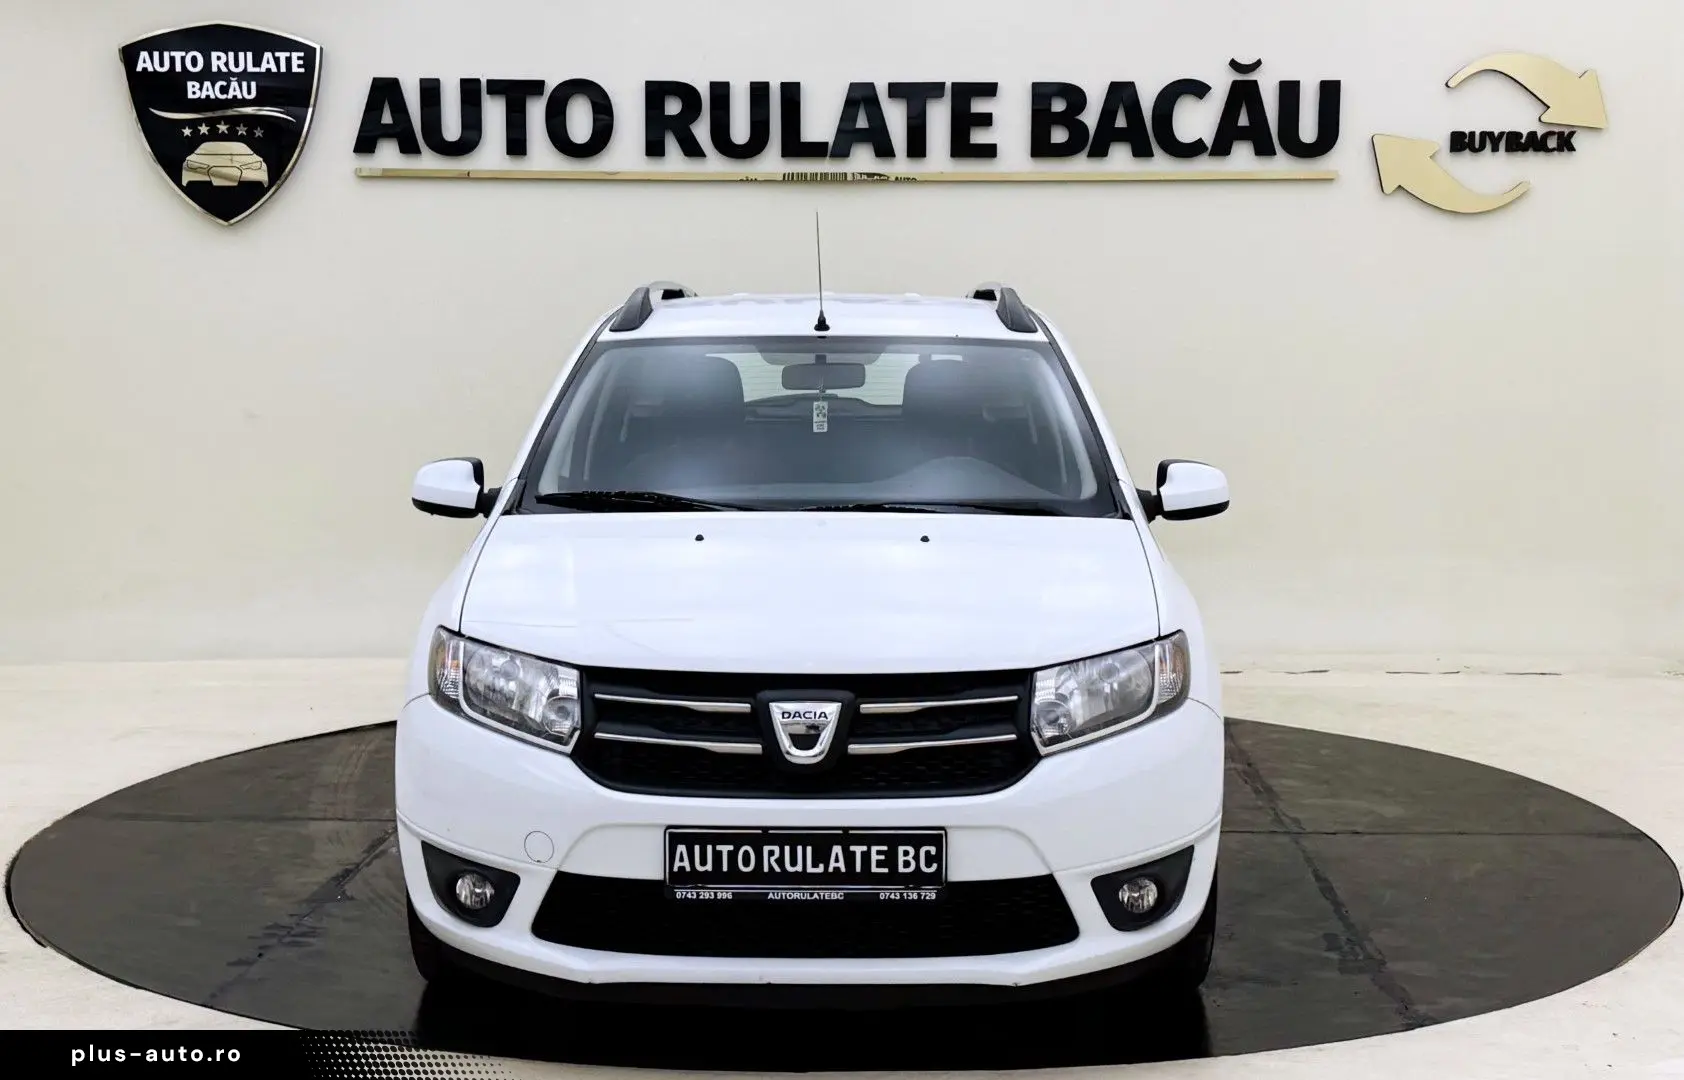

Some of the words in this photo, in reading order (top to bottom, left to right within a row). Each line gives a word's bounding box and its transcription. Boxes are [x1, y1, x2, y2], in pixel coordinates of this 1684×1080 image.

[136, 51, 204, 73] AUTO
[211, 51, 305, 73] RULATE
[186, 77, 257, 100] BACĂU
[353, 77, 614, 158] AUTO
[645, 80, 998, 159] RULATE
[1030, 59, 1341, 159] BACĂU
[1449, 130, 1577, 154] BUYBACK
[781, 710, 829, 720] DACIA
[673, 844, 756, 873] AUTO
[762, 845, 889, 873] RULATE
[897, 845, 938, 873] BC
[675, 891, 697, 900] 0743
[698, 891, 715, 900] 293
[716, 891, 733, 900] 996
[767, 891, 845, 900] AUTORULATEBC
[879, 891, 901, 900] 0743
[902, 891, 919, 900] 136
[920, 891, 937, 900] 729
